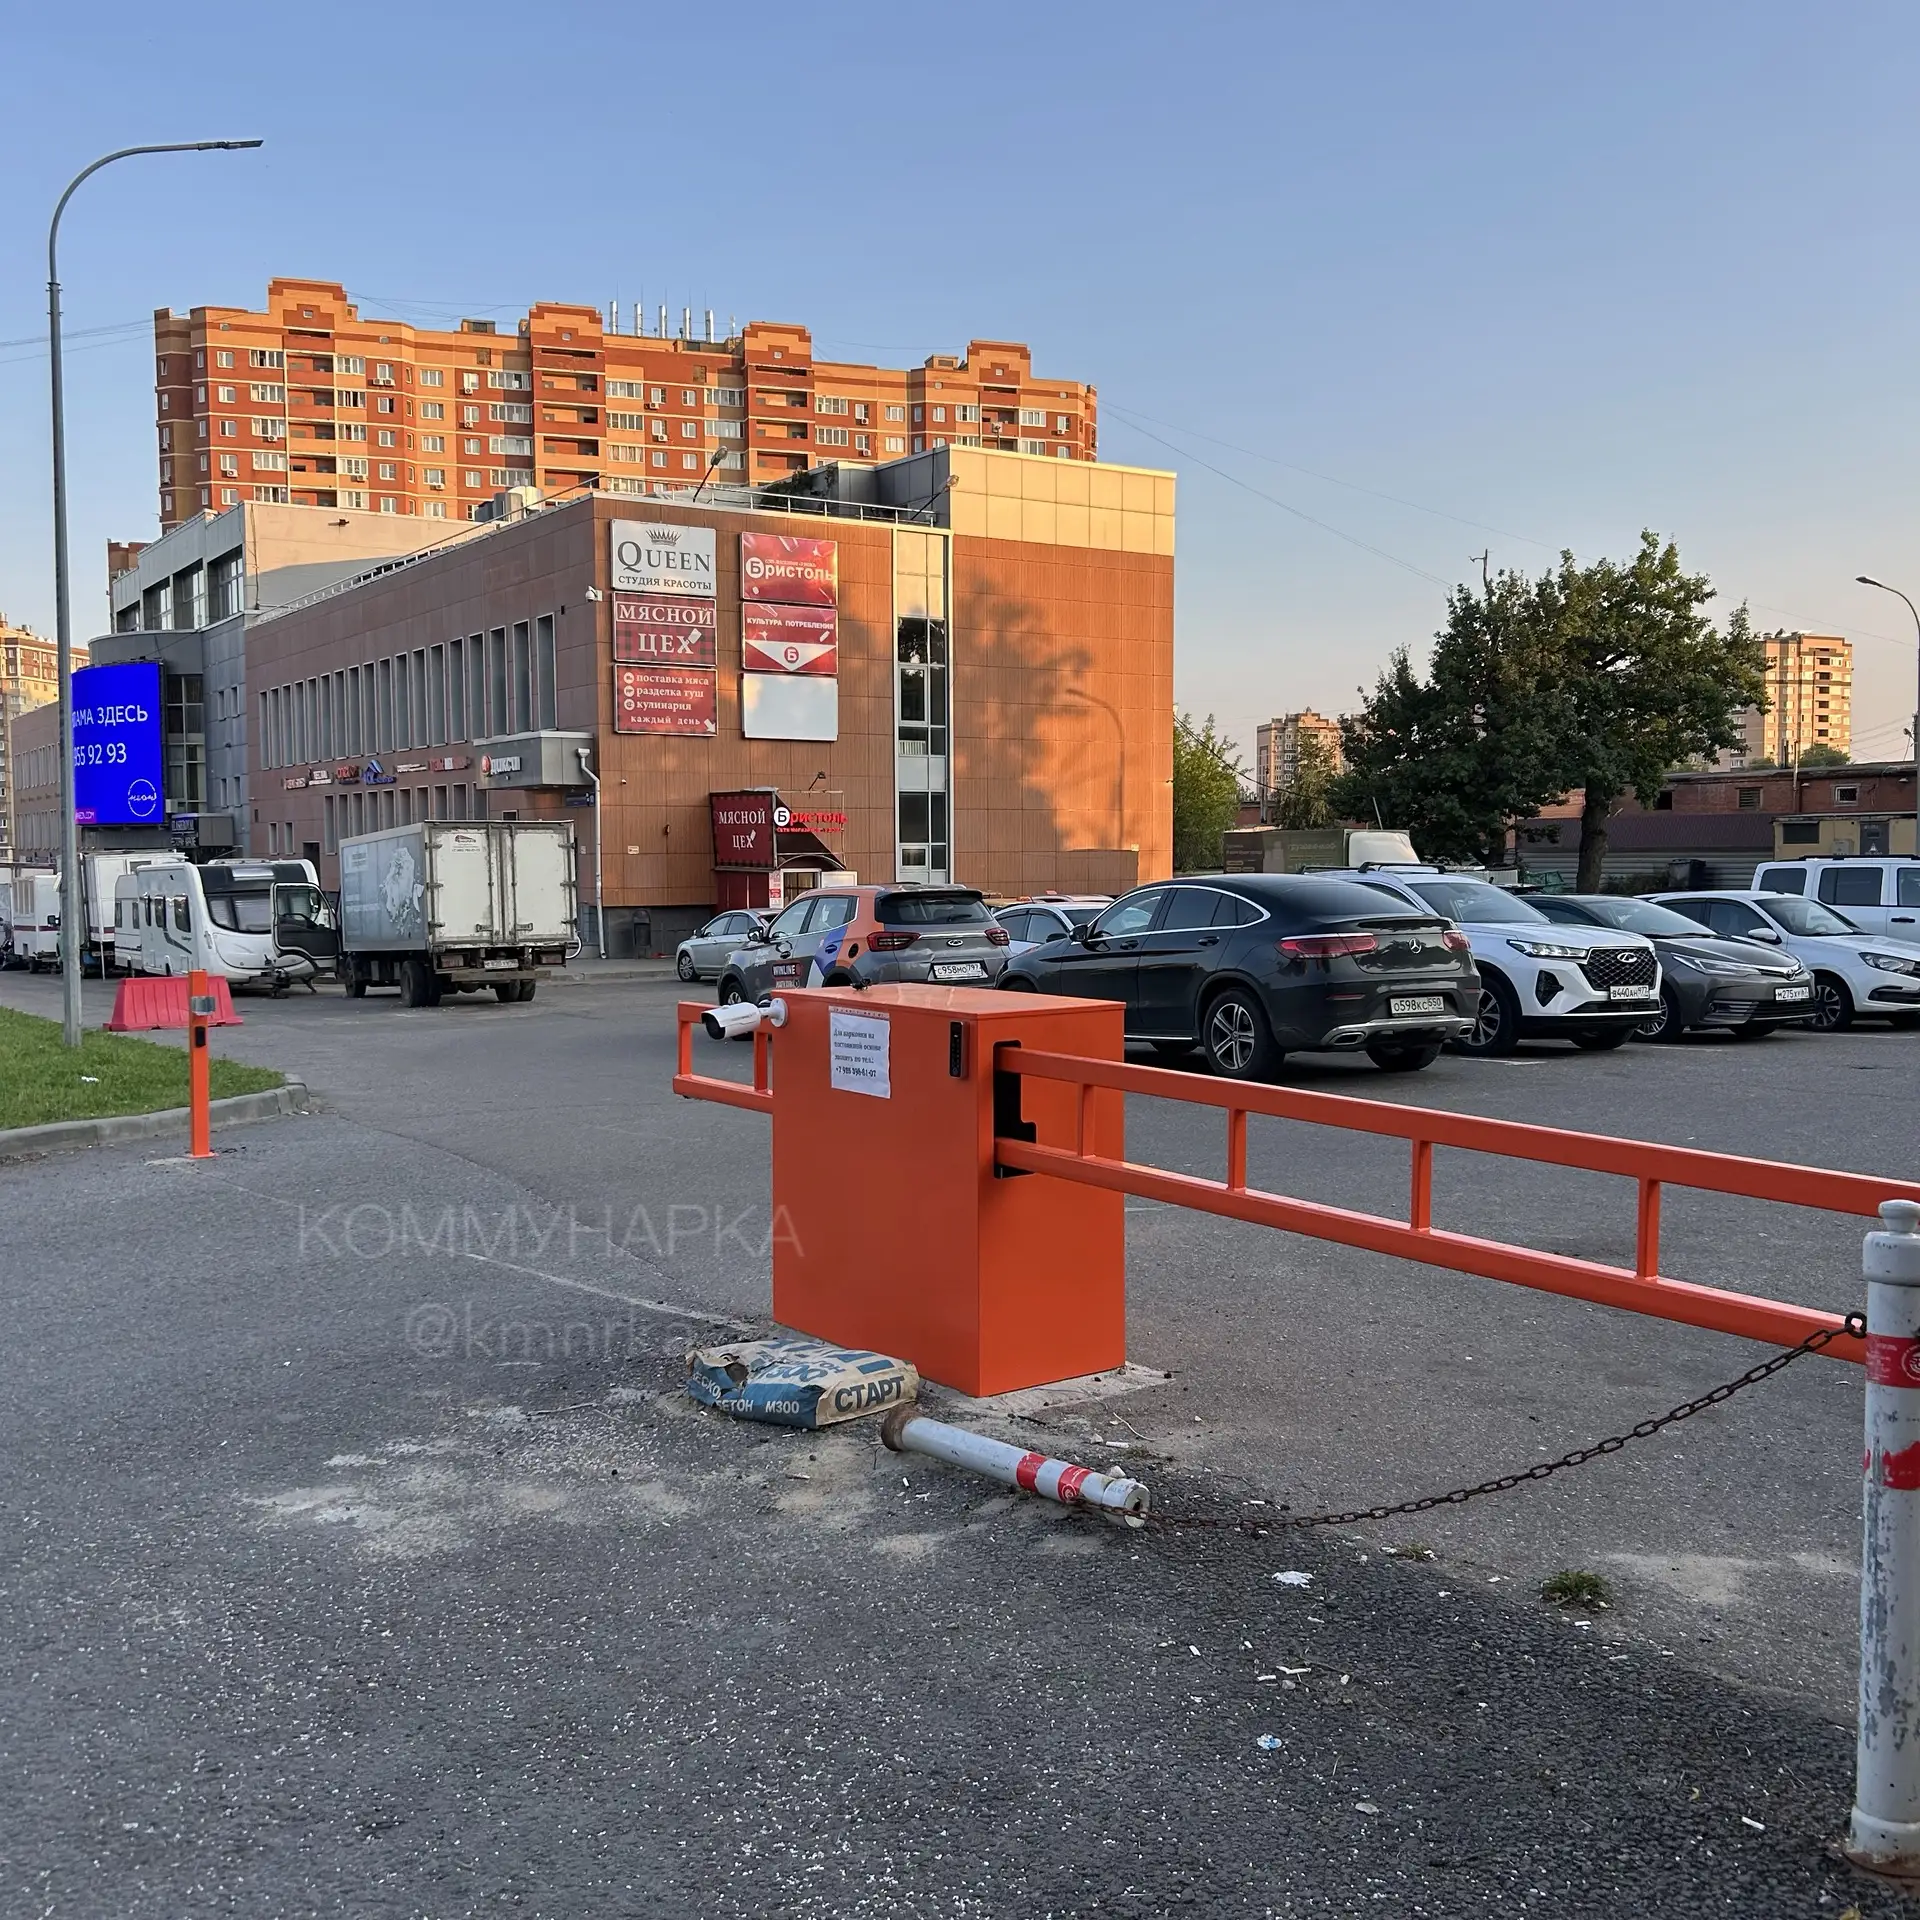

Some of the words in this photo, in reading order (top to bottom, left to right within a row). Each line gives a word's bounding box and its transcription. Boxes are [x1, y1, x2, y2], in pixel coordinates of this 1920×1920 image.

[617, 541, 711, 573] QUEEN
[748, 558, 835, 581] Бристоль
[618, 575, 660, 587] СТУДИЯ
[663, 578, 712, 590] КРАСОТЫ
[619, 604, 712, 625] МЯСНОЙ
[747, 617, 783, 627] КУЛЬТУРА
[785, 619, 835, 630] ПОТРЕБЛЕНИЯ
[638, 632, 694, 657] ЦЕХ
[786, 649, 798, 661] Б
[636, 673, 683, 684] поставка
[685, 677, 709, 686] мяса
[636, 686, 682, 697] разделка
[683, 689, 705, 698] туш
[636, 698, 692, 712] кулинария
[97, 705, 149, 727] ЗДЕСЬ
[630, 715, 672, 725] каждый
[677, 717, 701, 726] день
[88, 744, 103, 766] 92
[106, 743, 127, 764] 93
[719, 808, 766, 825] МЯСНОЙ
[776, 809, 847, 826] Бристоль
[732, 833, 754, 850] ЦЕХ
[834, 1375, 905, 1413] СТАРТ
[765, 1400, 800, 1414] М300
